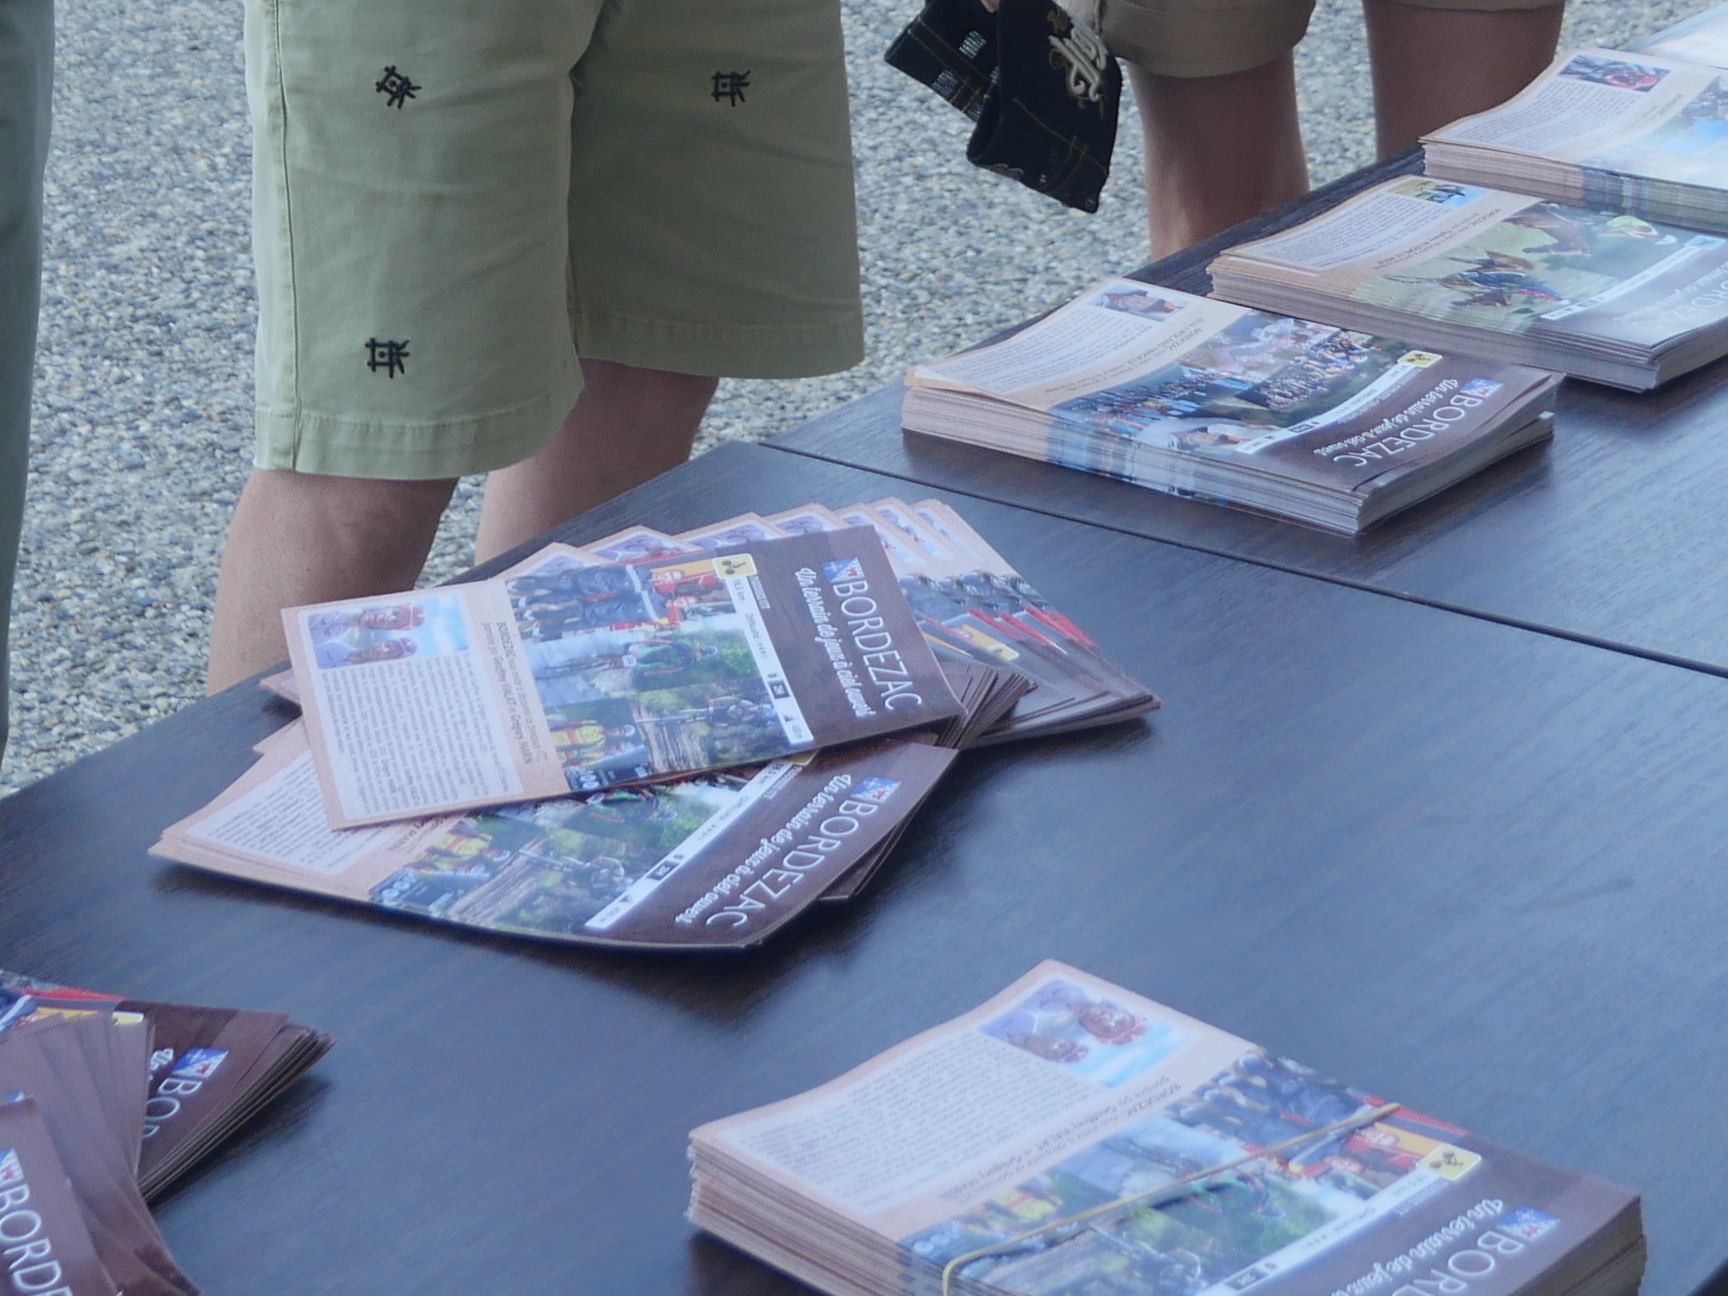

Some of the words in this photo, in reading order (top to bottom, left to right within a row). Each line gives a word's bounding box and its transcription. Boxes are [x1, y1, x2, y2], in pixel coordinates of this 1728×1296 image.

[1333, 393, 1483, 467] BORDEZAC
[794, 568, 814, 585] Un
[832, 580, 923, 711] BORDEZAC
[823, 775, 851, 791] Un
[704, 796, 878, 928] BORDEZAC
